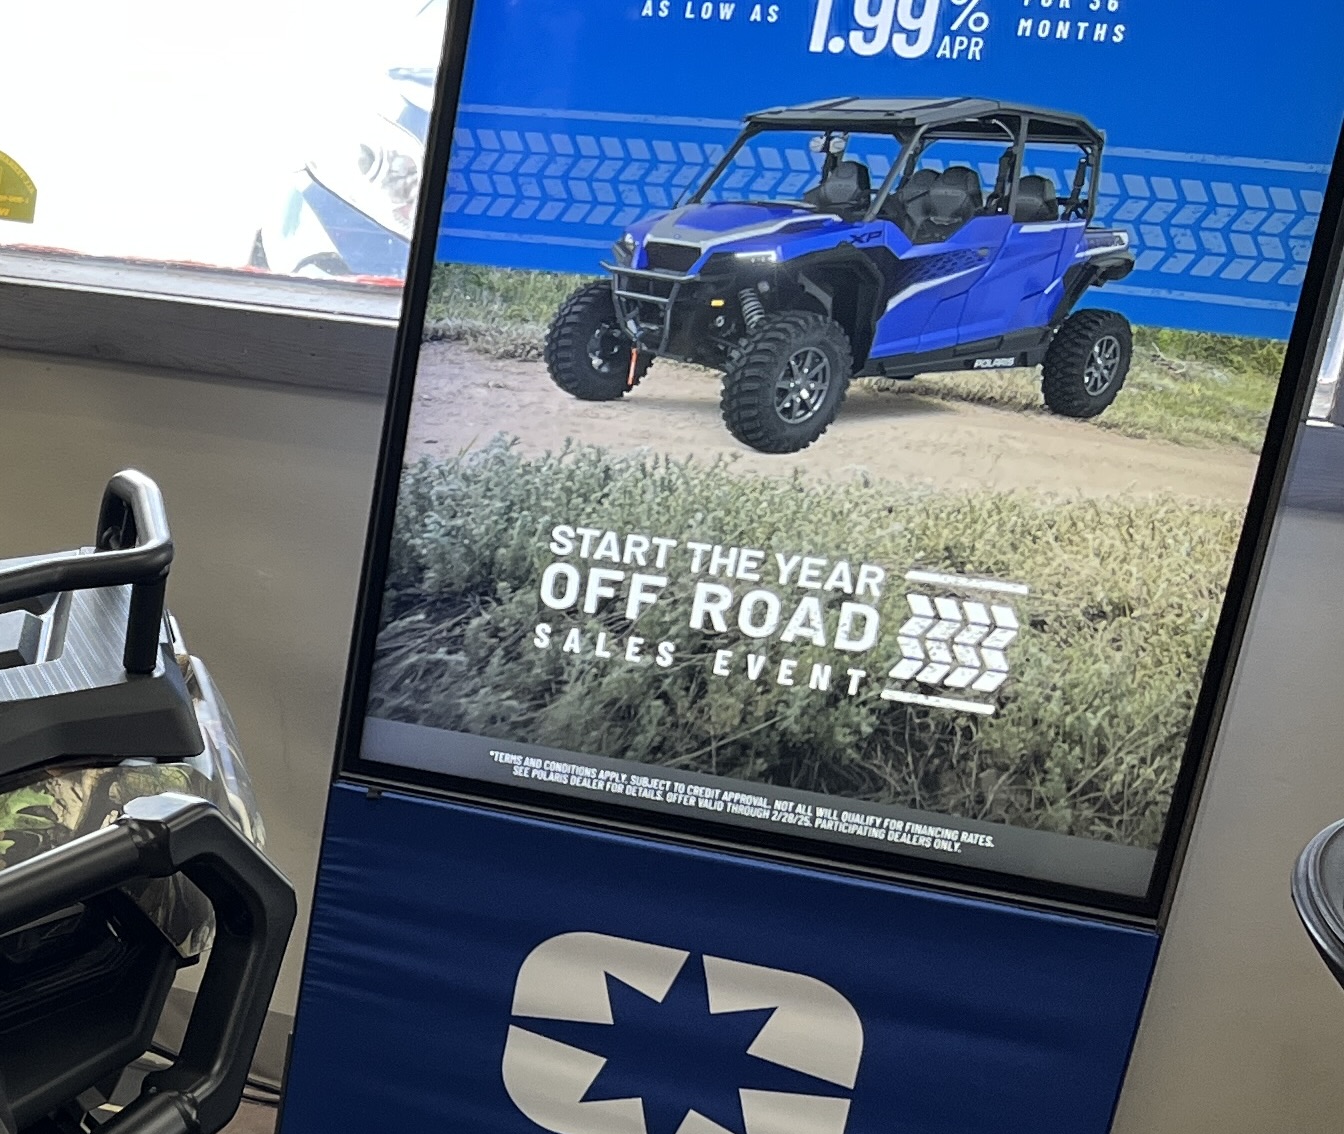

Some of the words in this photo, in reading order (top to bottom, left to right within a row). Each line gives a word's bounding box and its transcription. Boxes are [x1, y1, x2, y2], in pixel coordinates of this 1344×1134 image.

[641, 0, 670, 17] AS
[684, 1, 735, 20] LOW
[749, 3, 779, 23] AS
[1017, 18, 1126, 43] MONTHS
[936, 35, 984, 60] APR
[849, 230, 883, 244] XP
[973, 357, 1015, 369] POLARIS
[549, 523, 678, 569] START
[687, 539, 765, 582] THE
[775, 552, 886, 598] YEAR
[539, 561, 668, 621] OFF
[689, 581, 882, 652] ROAD
[533, 622, 676, 668] SALES
[712, 649, 867, 696] EVENT
[512, 765, 531, 778] SEE
[531, 769, 569, 785] POLARIS
[569, 775, 605, 791] DEALER
[605, 781, 624, 794] FOR
[625, 784, 664, 802] DETAILS.
[666, 792, 696, 807] OFFER
[697, 797, 724, 811] VALID
[725, 801, 770, 820] THROUGH
[770, 810, 813, 828] 2/28/25.
[814, 818, 886, 840] PARTICIPATING
[886, 829, 932, 848] DEALERS
[933, 837, 962, 853] ONLY.
[523, 757, 543, 769] AND
[543, 760, 598, 778] CONDITIONS
[598, 770, 629, 784] APPLY.
[630, 774, 671, 791] SUBJECT
[673, 782, 686, 794] TO
[687, 784, 722, 800] CREDIT
[721, 790, 772, 811] APPROVAL.
[773, 799, 794, 812] NOT
[794, 803, 814, 817] ALL
[815, 806, 839, 821] WILL
[841, 811, 884, 828] QUALIFY
[883, 818, 904, 832] FOR
[904, 821, 959, 842] FINANCING
[960, 830, 995, 848] RATES.
